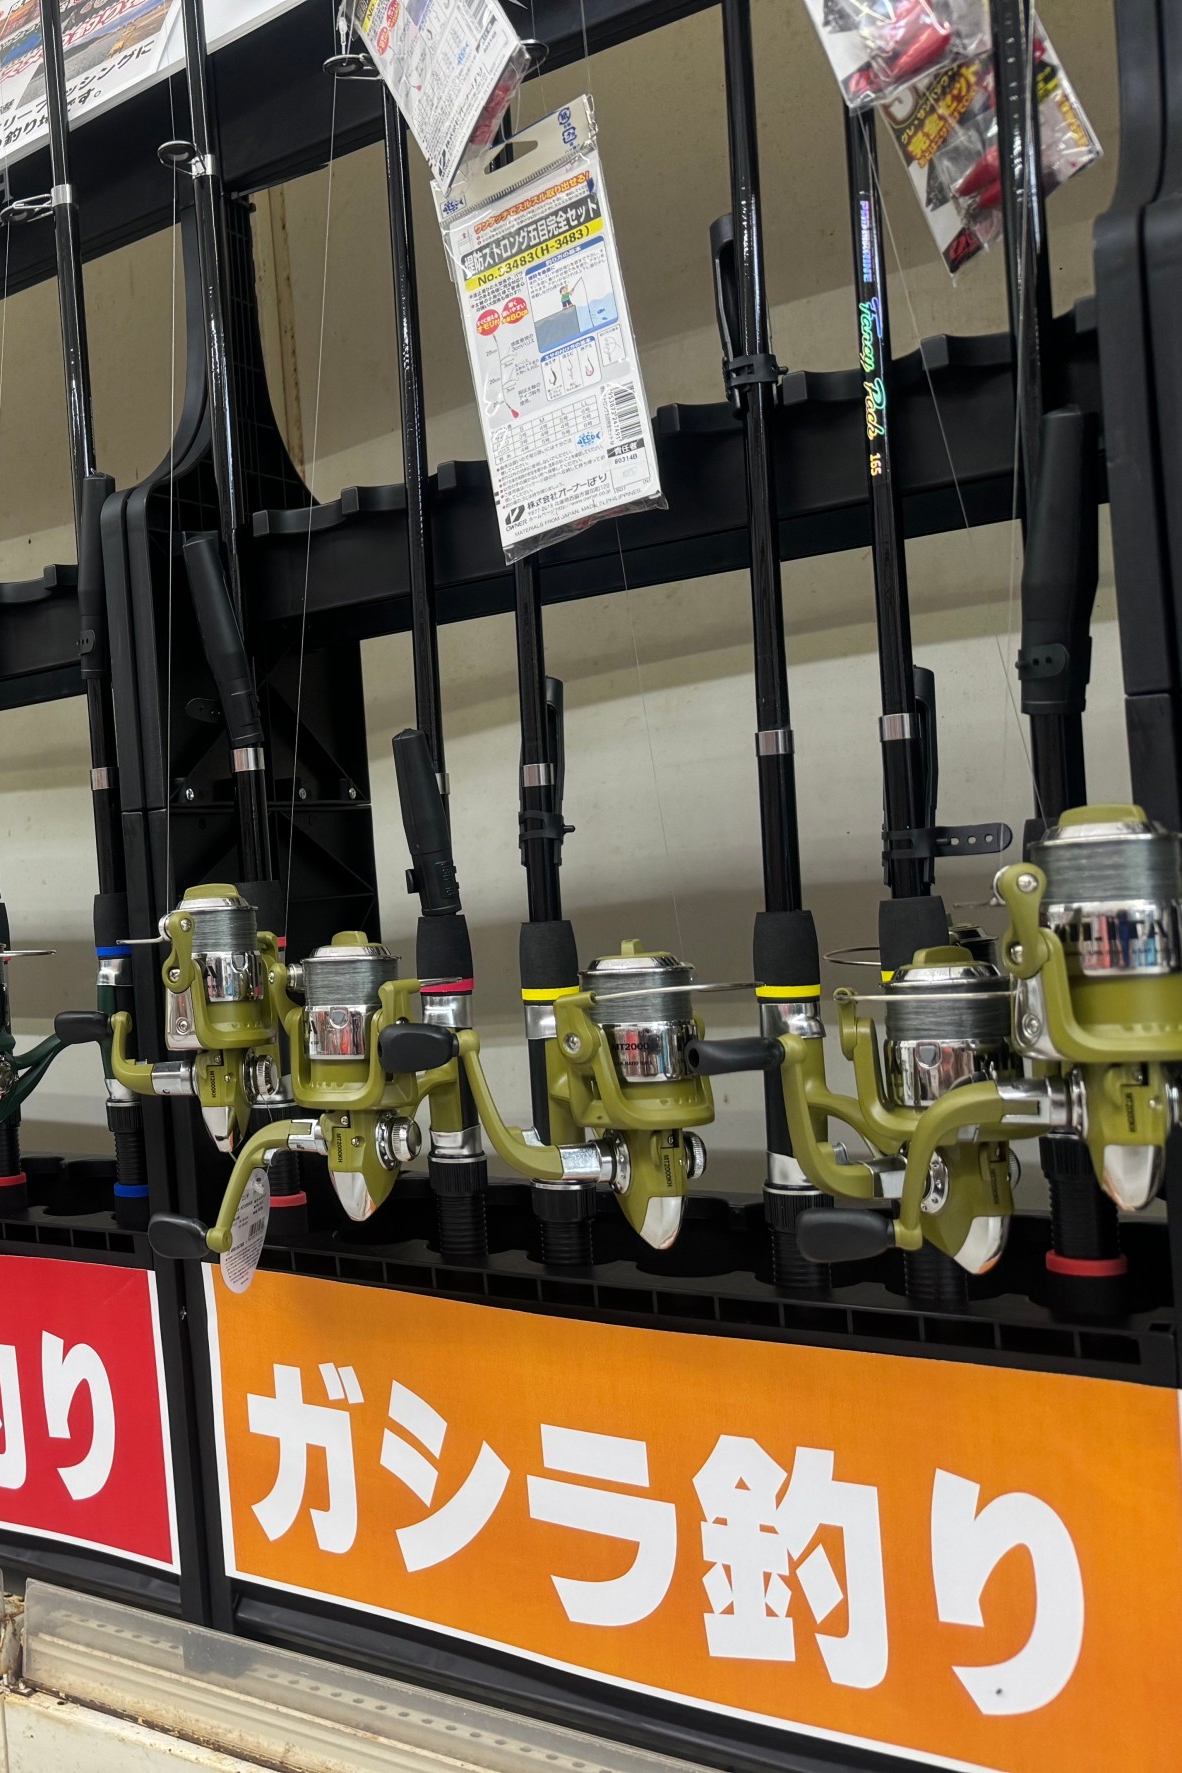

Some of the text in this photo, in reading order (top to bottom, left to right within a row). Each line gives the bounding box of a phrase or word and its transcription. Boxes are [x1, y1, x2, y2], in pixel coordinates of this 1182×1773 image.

[863, 377, 886, 441] Pack
[870, 452, 882, 476] 165
[527, 473, 608, 510] 株式会社オーナーばり
[505, 518, 529, 532] OWNER
[245, 1360, 1086, 1717] ガシラ釣り
